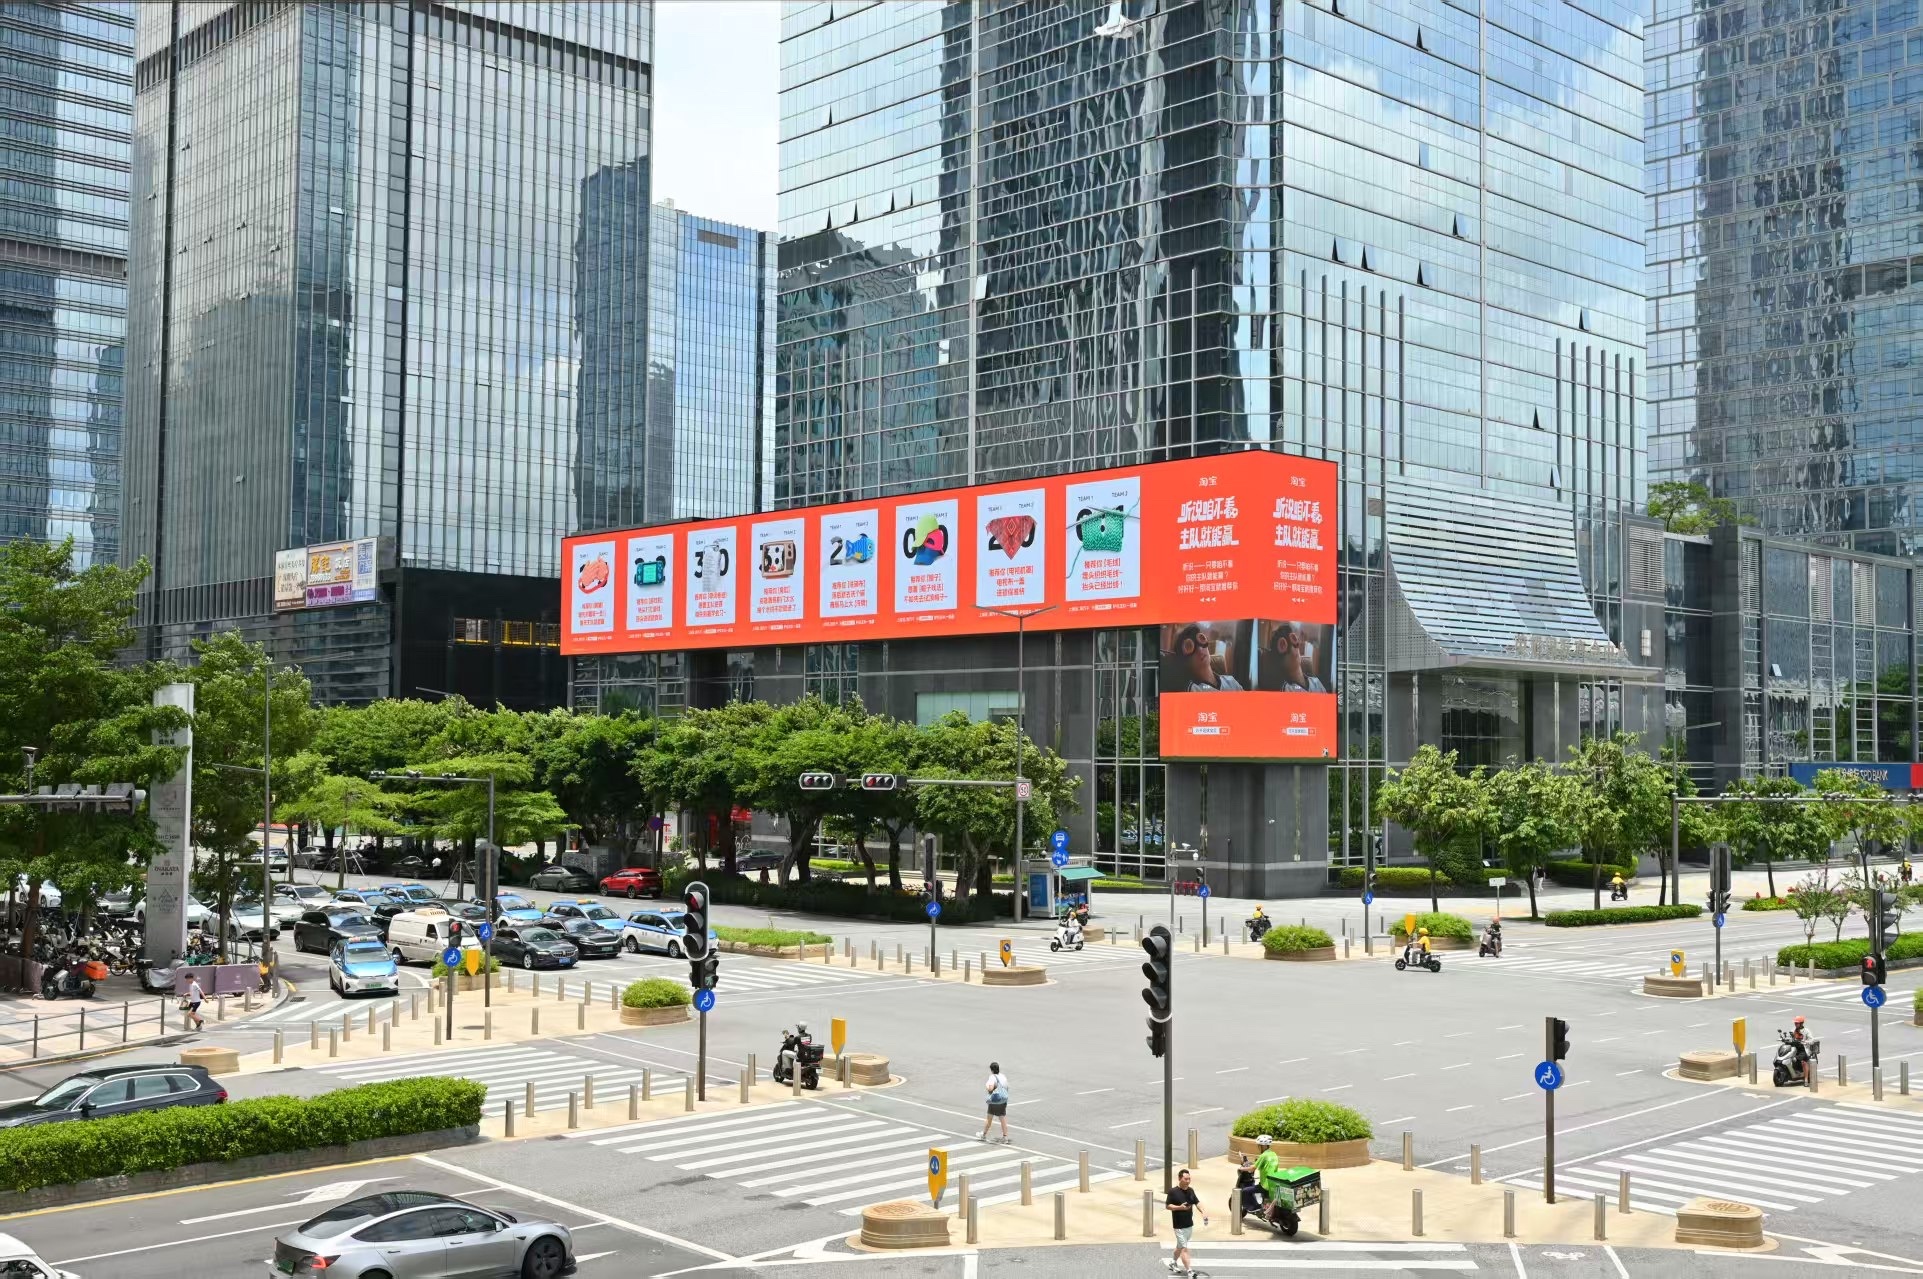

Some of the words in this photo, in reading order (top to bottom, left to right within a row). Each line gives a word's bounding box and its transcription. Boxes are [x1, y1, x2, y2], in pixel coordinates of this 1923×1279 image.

[1198, 476, 1218, 487] 淘宝
[1290, 476, 1306, 488] 淘宝
[1179, 524, 1240, 550] 主队就能赢
[830, 536, 843, 566] 2
[1197, 712, 1218, 723] 淘宝
[1290, 712, 1307, 723] 淘宝
[1872, 769, 1888, 782] BANK
